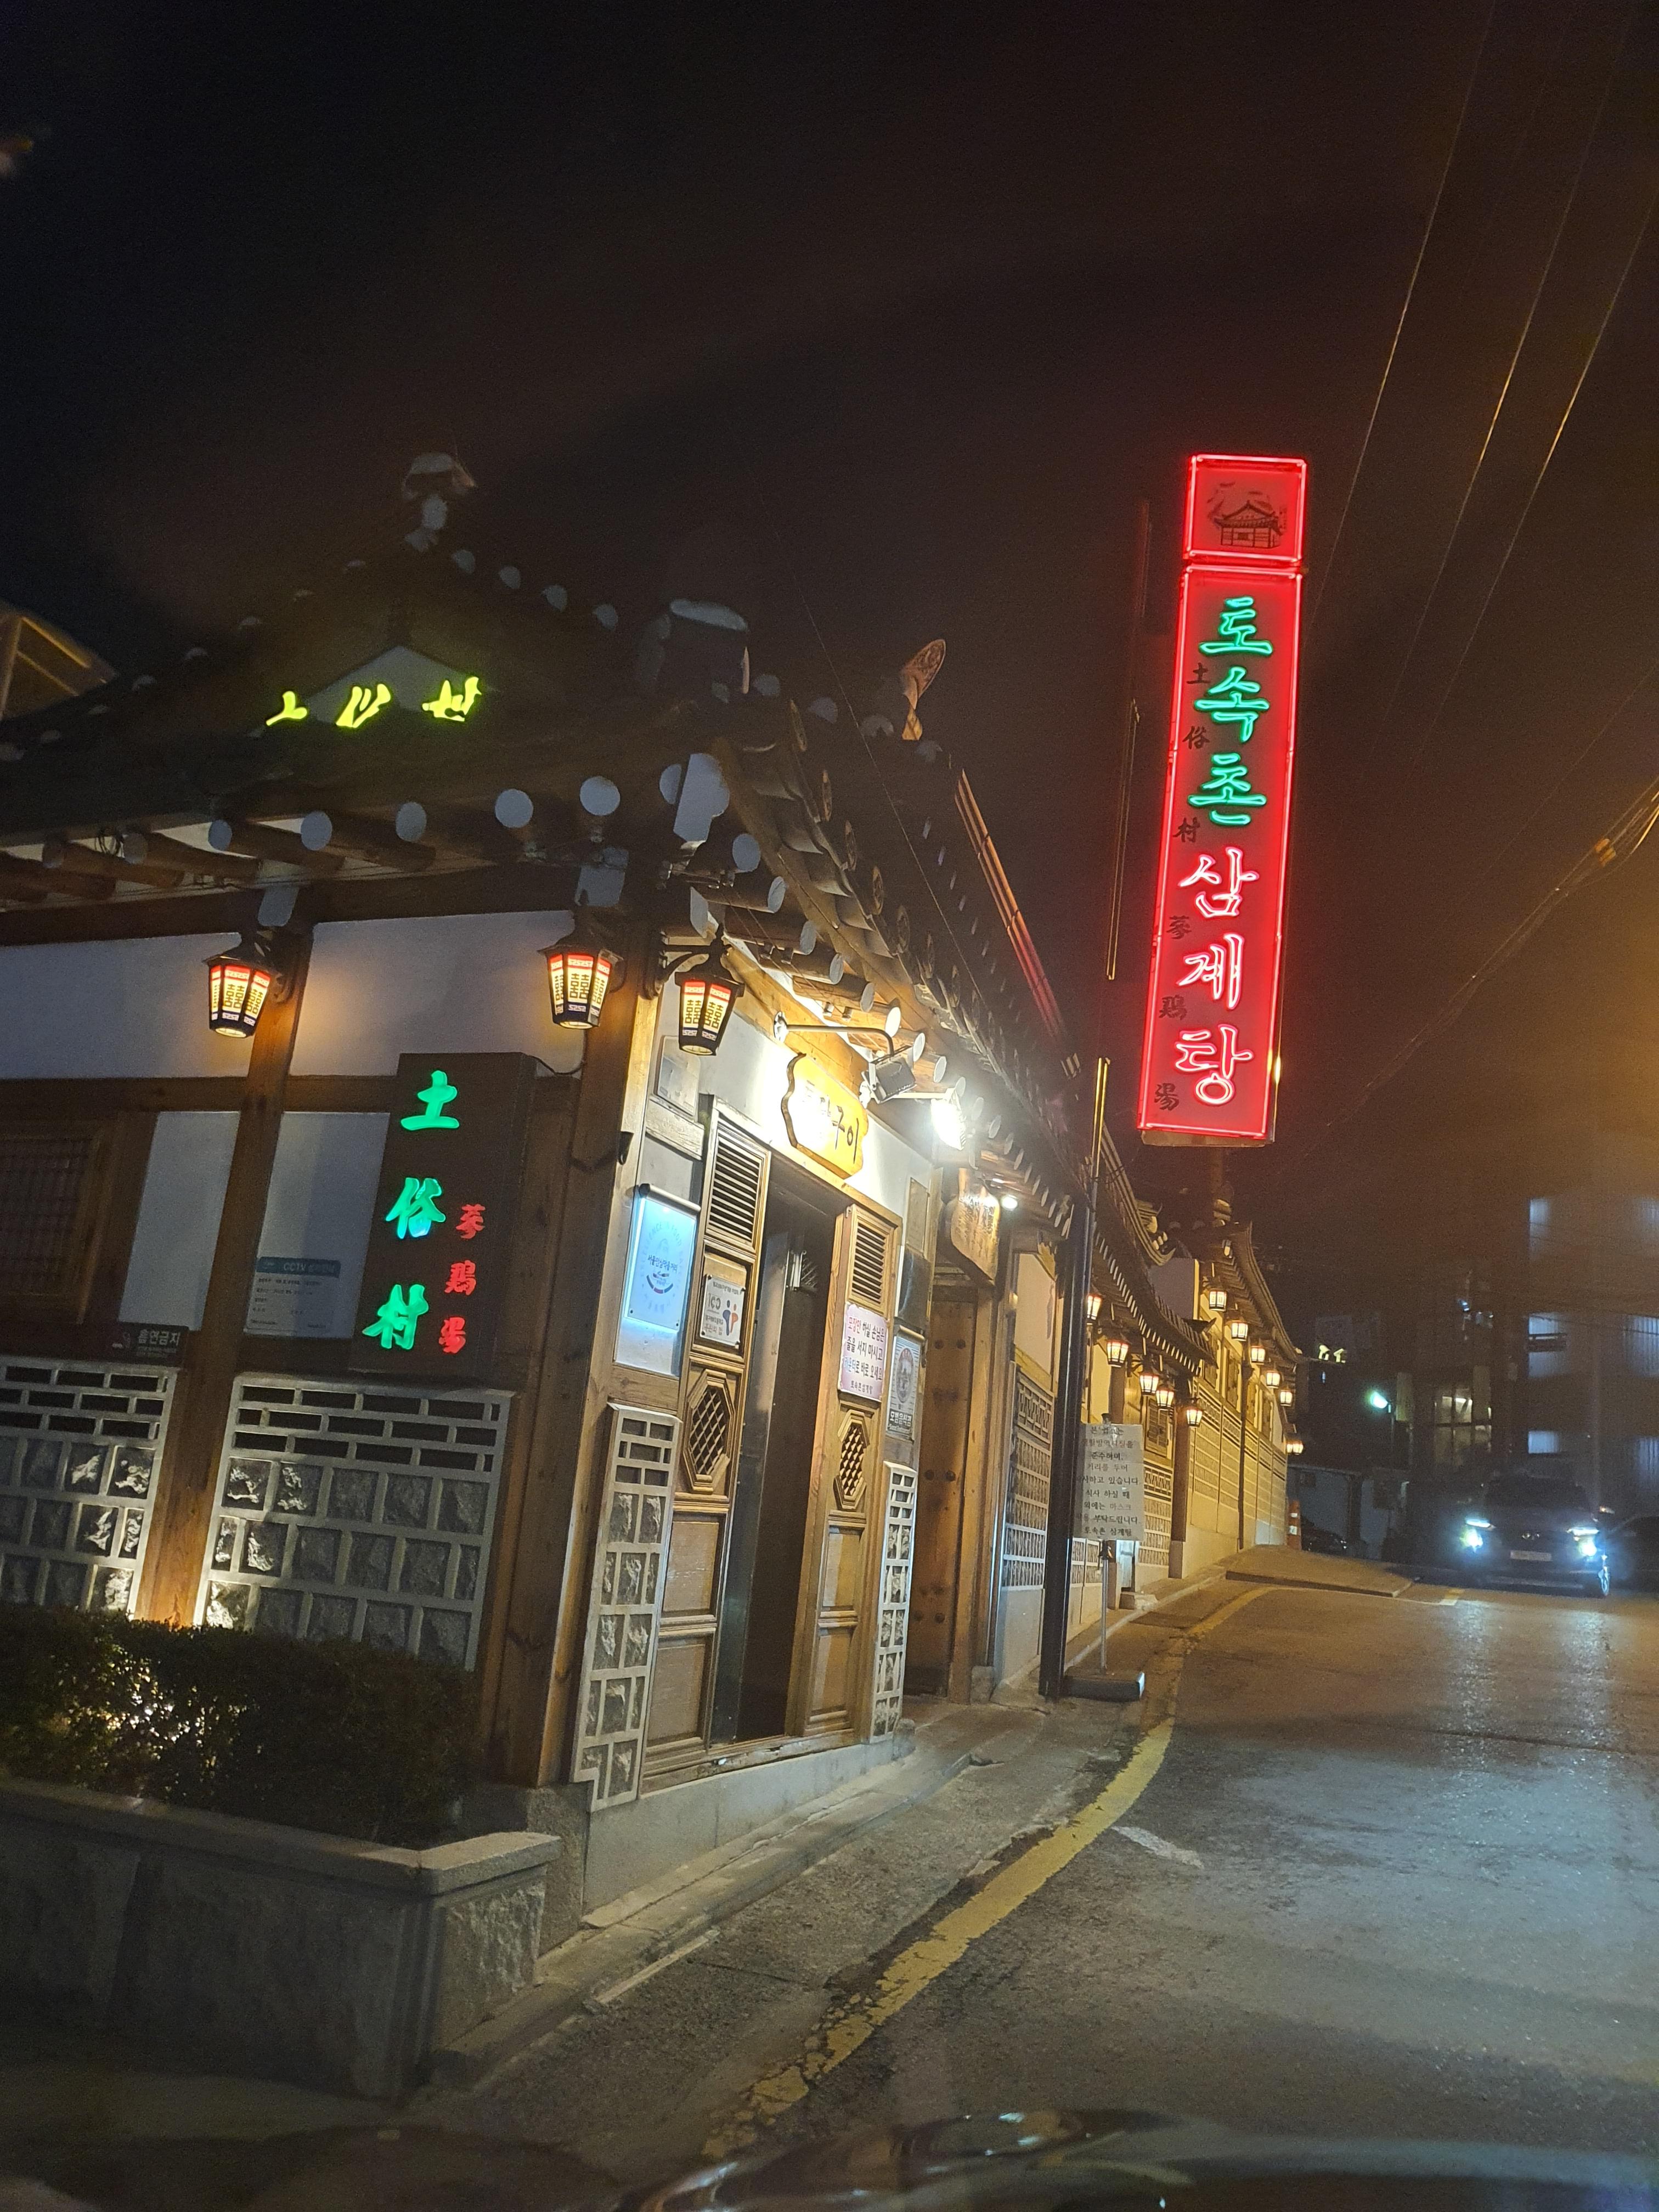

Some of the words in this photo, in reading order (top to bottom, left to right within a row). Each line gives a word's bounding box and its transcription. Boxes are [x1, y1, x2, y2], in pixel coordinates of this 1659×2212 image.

[1188, 596, 1273, 826] 토속촌
[1174, 846, 1260, 1105] 삼계탕
[362, 1070, 460, 1350] 土俗村
[862, 1322, 871, 1338] 하실
[872, 1325, 885, 1342] 손님은
[847, 1336, 856, 1353] 줄을
[857, 1340, 867, 1357] 서지
[868, 1345, 883, 1361] 마시고
[861, 1362, 869, 1377] 바로
[870, 1365, 883, 1381] 오세요
[889, 1411, 912, 1426] 모범음식점
[1104, 1489, 1118, 1498] 하실
